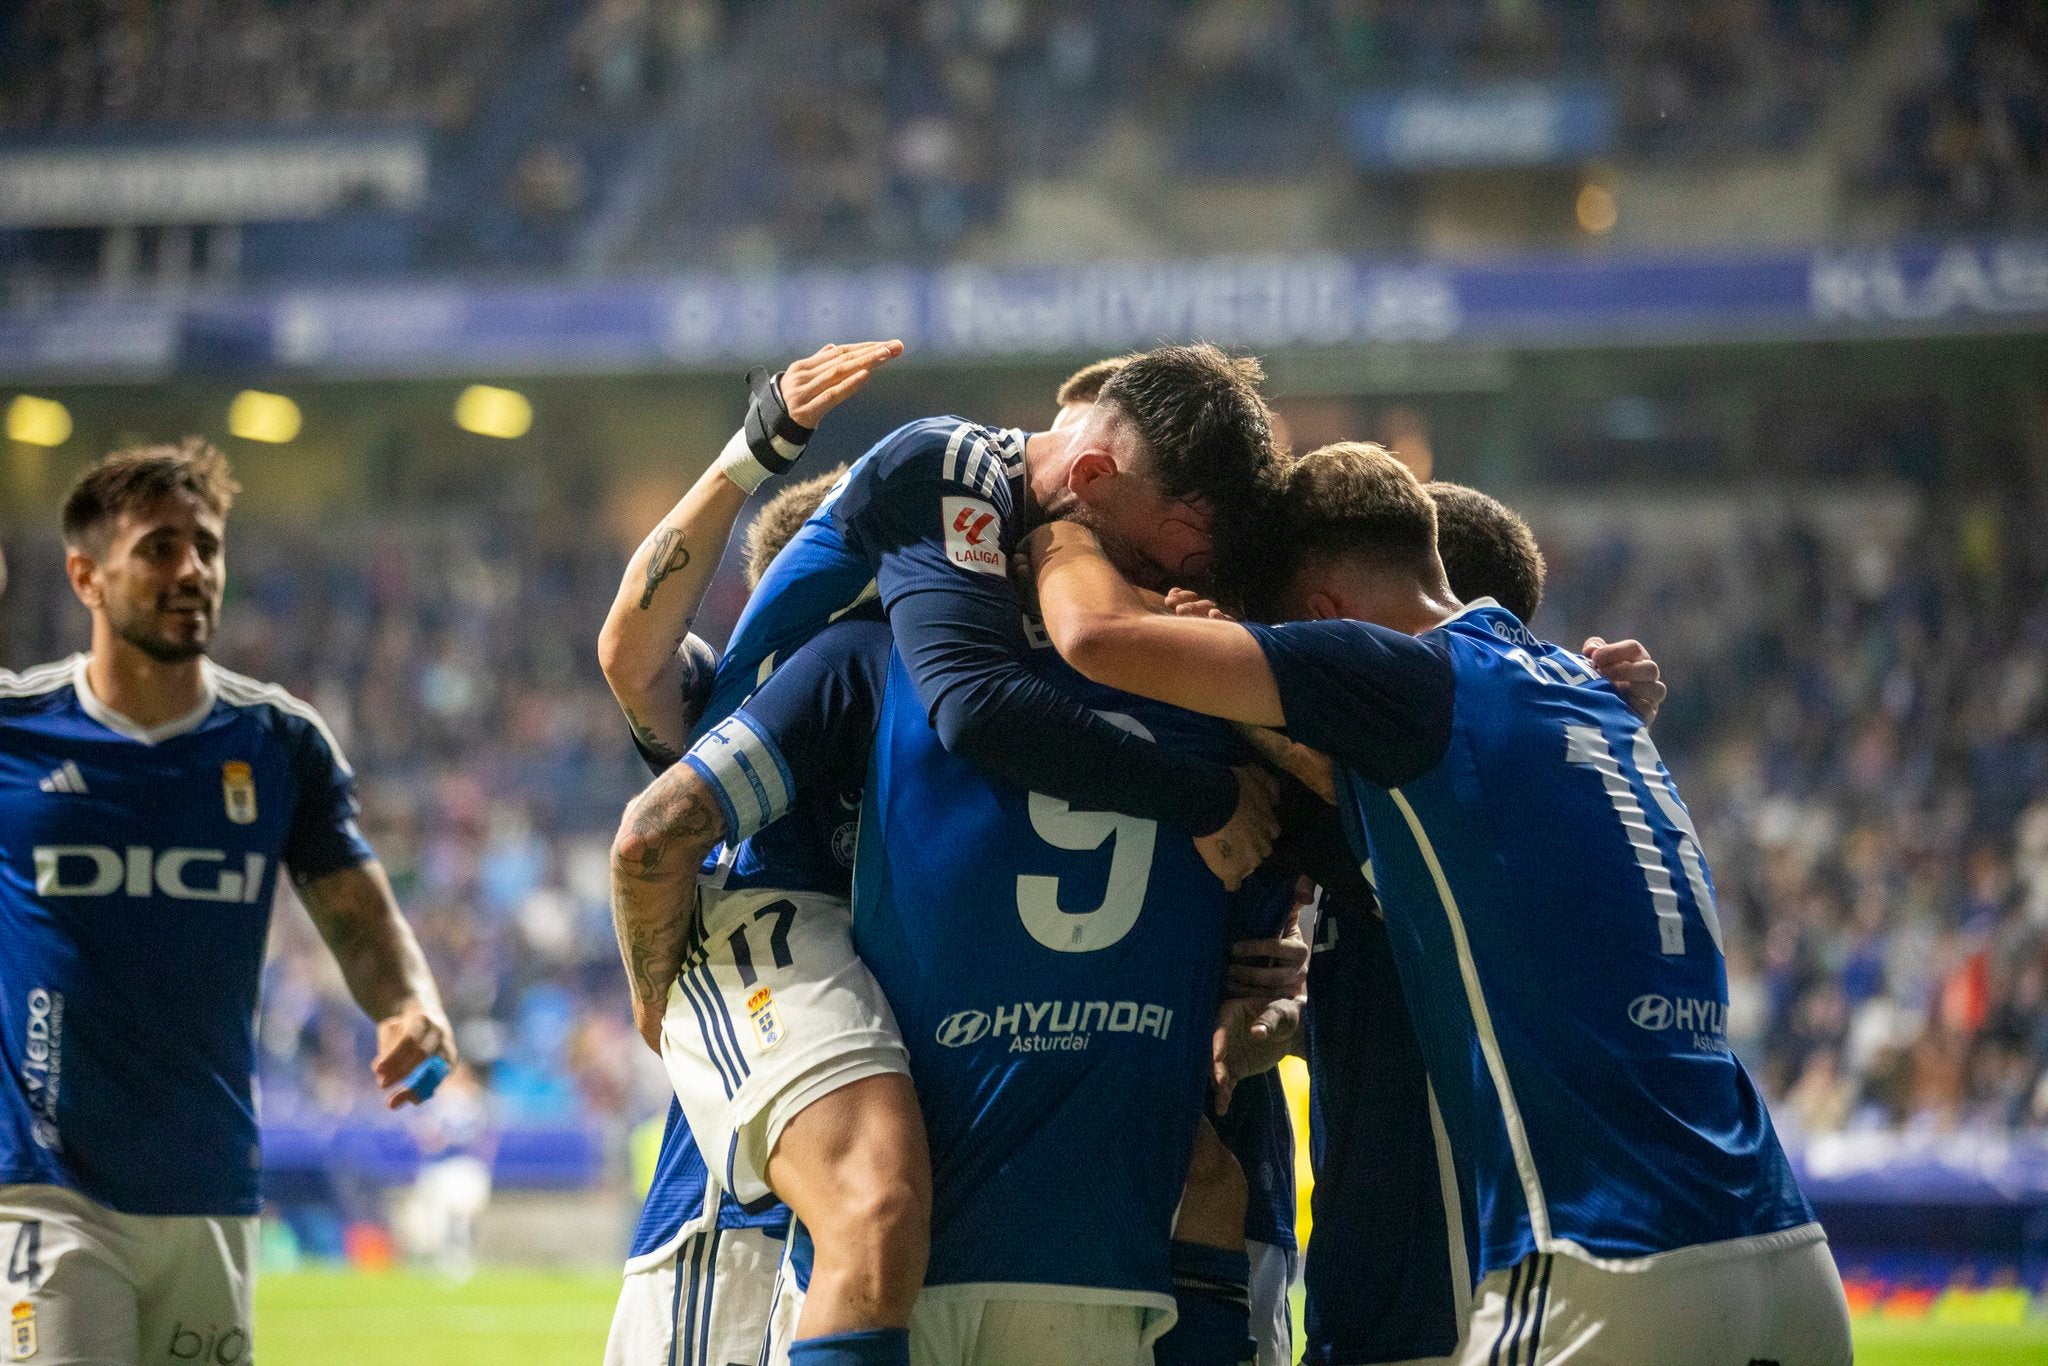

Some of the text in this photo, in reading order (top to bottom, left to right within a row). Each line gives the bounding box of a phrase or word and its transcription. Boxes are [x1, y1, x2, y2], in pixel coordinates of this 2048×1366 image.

[955, 550, 999, 566] LALIGA
[1016, 708, 1160, 953] 9
[33, 844, 267, 904] DIGI
[728, 899, 798, 990] 17
[21, 987, 51, 1106] VIEDO
[992, 1000, 1173, 1041] HYUNDAI
[1008, 1032, 1092, 1053] Asturdai
[7, 1220, 42, 1289] 4
